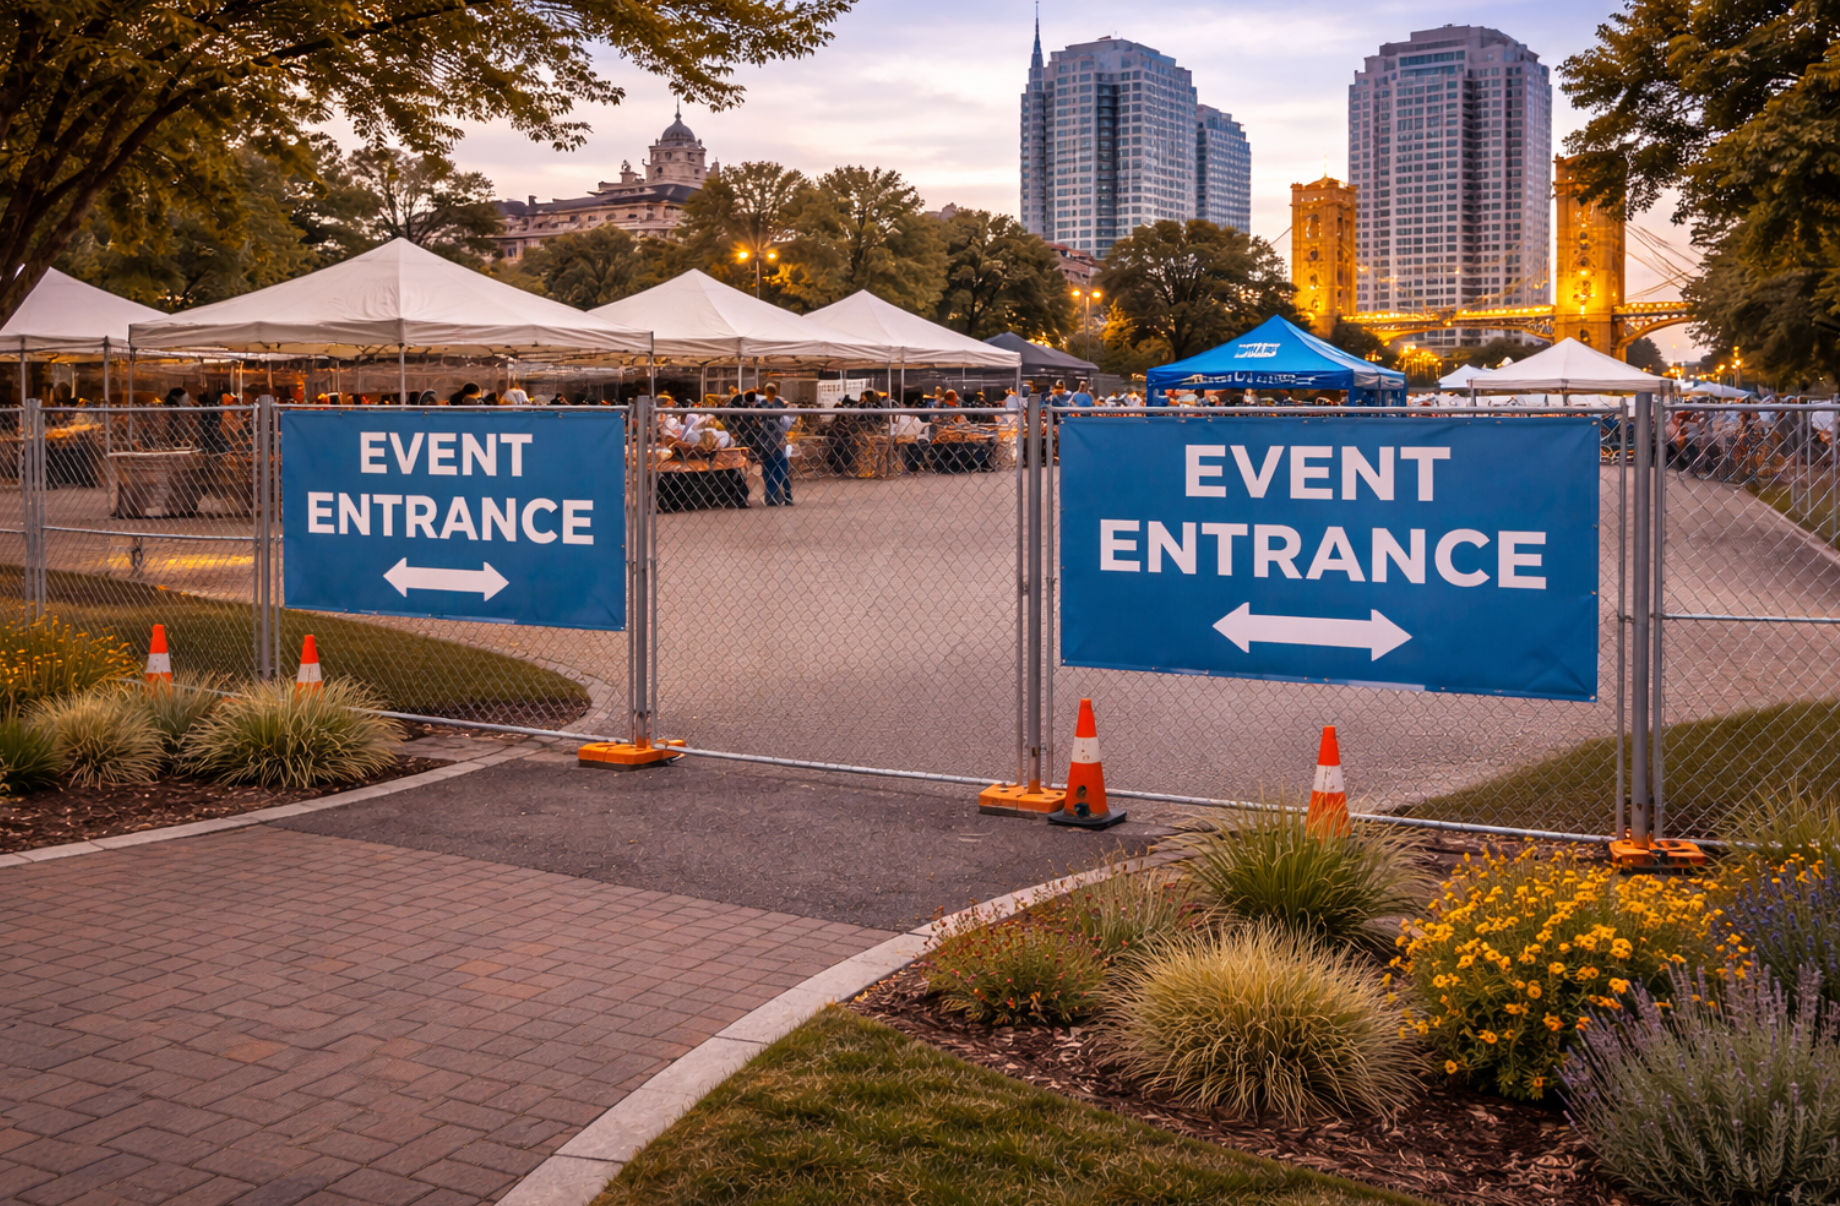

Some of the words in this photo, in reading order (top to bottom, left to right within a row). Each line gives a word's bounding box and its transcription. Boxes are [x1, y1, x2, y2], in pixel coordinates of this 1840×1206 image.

[360, 431, 533, 477] EVENT
[1185, 444, 1452, 502] EVENT
[307, 491, 595, 547] ENTRANCE
[1099, 519, 1547, 590] ENTRANCE
